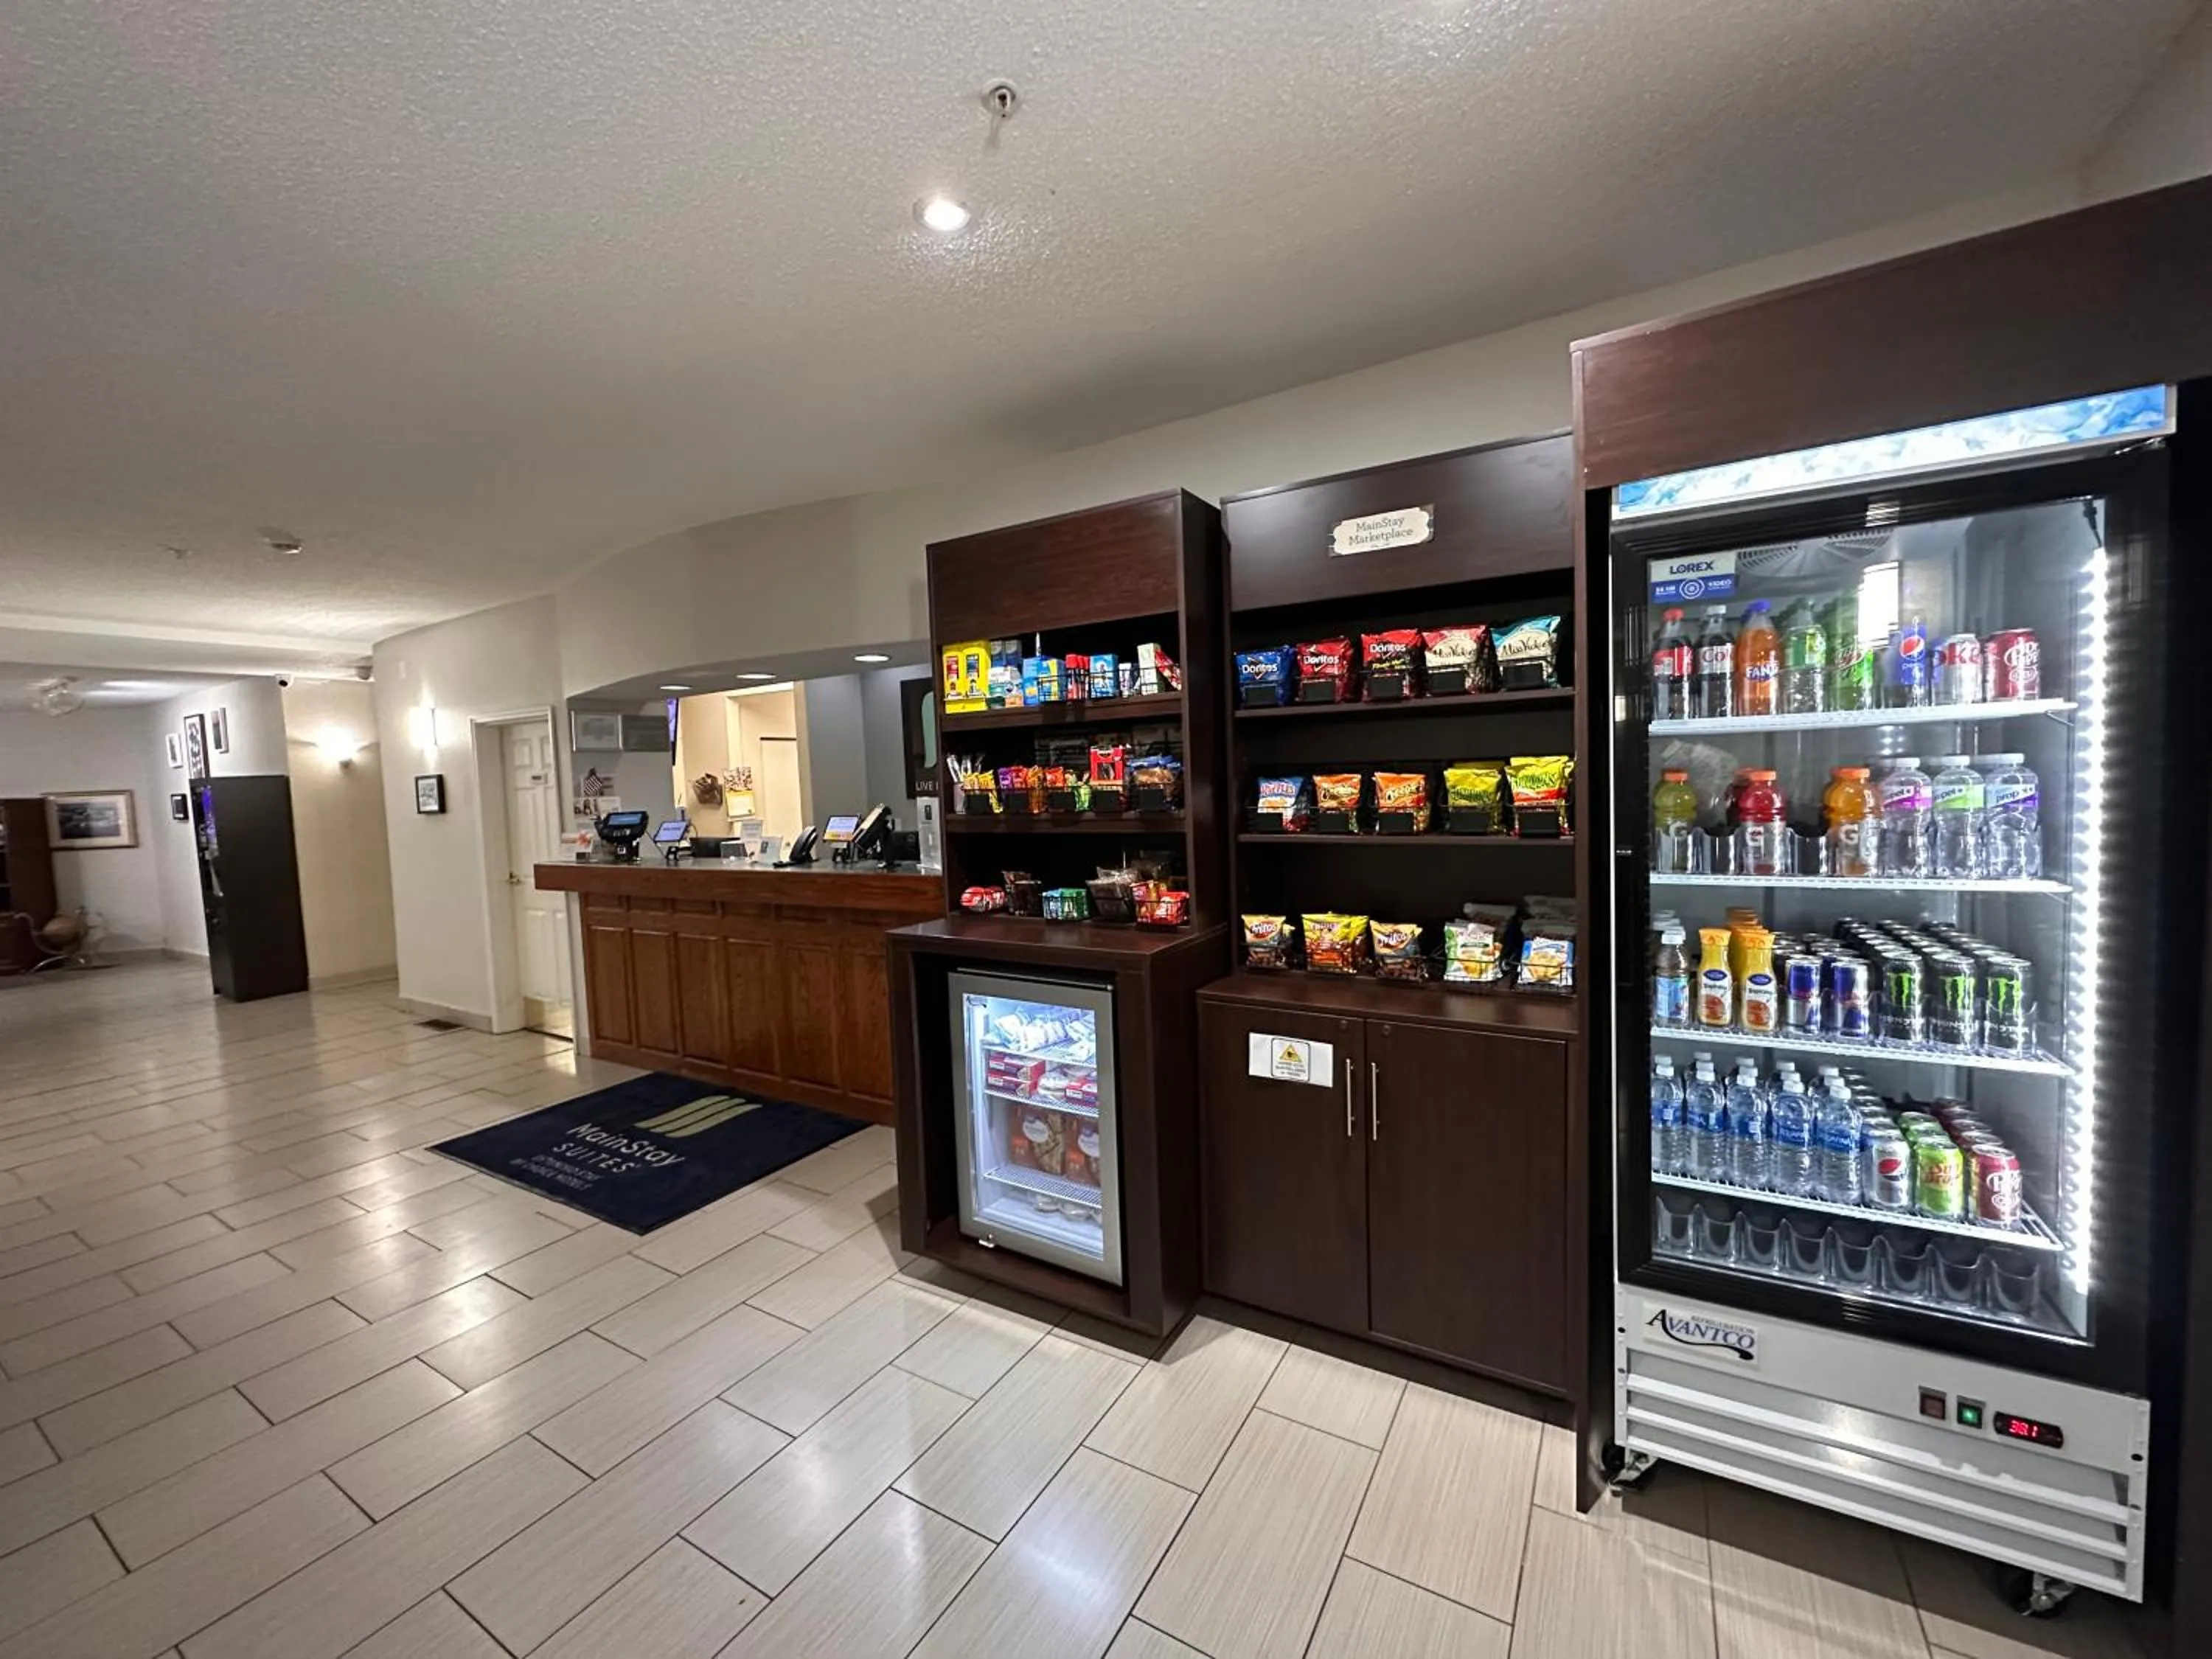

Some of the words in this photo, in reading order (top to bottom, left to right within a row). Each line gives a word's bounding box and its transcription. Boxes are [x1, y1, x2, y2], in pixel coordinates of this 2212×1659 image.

[1356, 517, 1405, 532] MainStay
[1349, 528, 1413, 546] Marketplace
[1670, 561, 1714, 574] LOREX
[1370, 643, 1407, 653] Doritos
[1304, 655, 1340, 664] Doritos
[1242, 662, 1279, 674] Doritos
[915, 781, 933, 791] LIVE
[566, 1122, 686, 1167] MainStay
[553, 1142, 636, 1174] SUITES
[1646, 1309, 1756, 1357] AVANTCO
